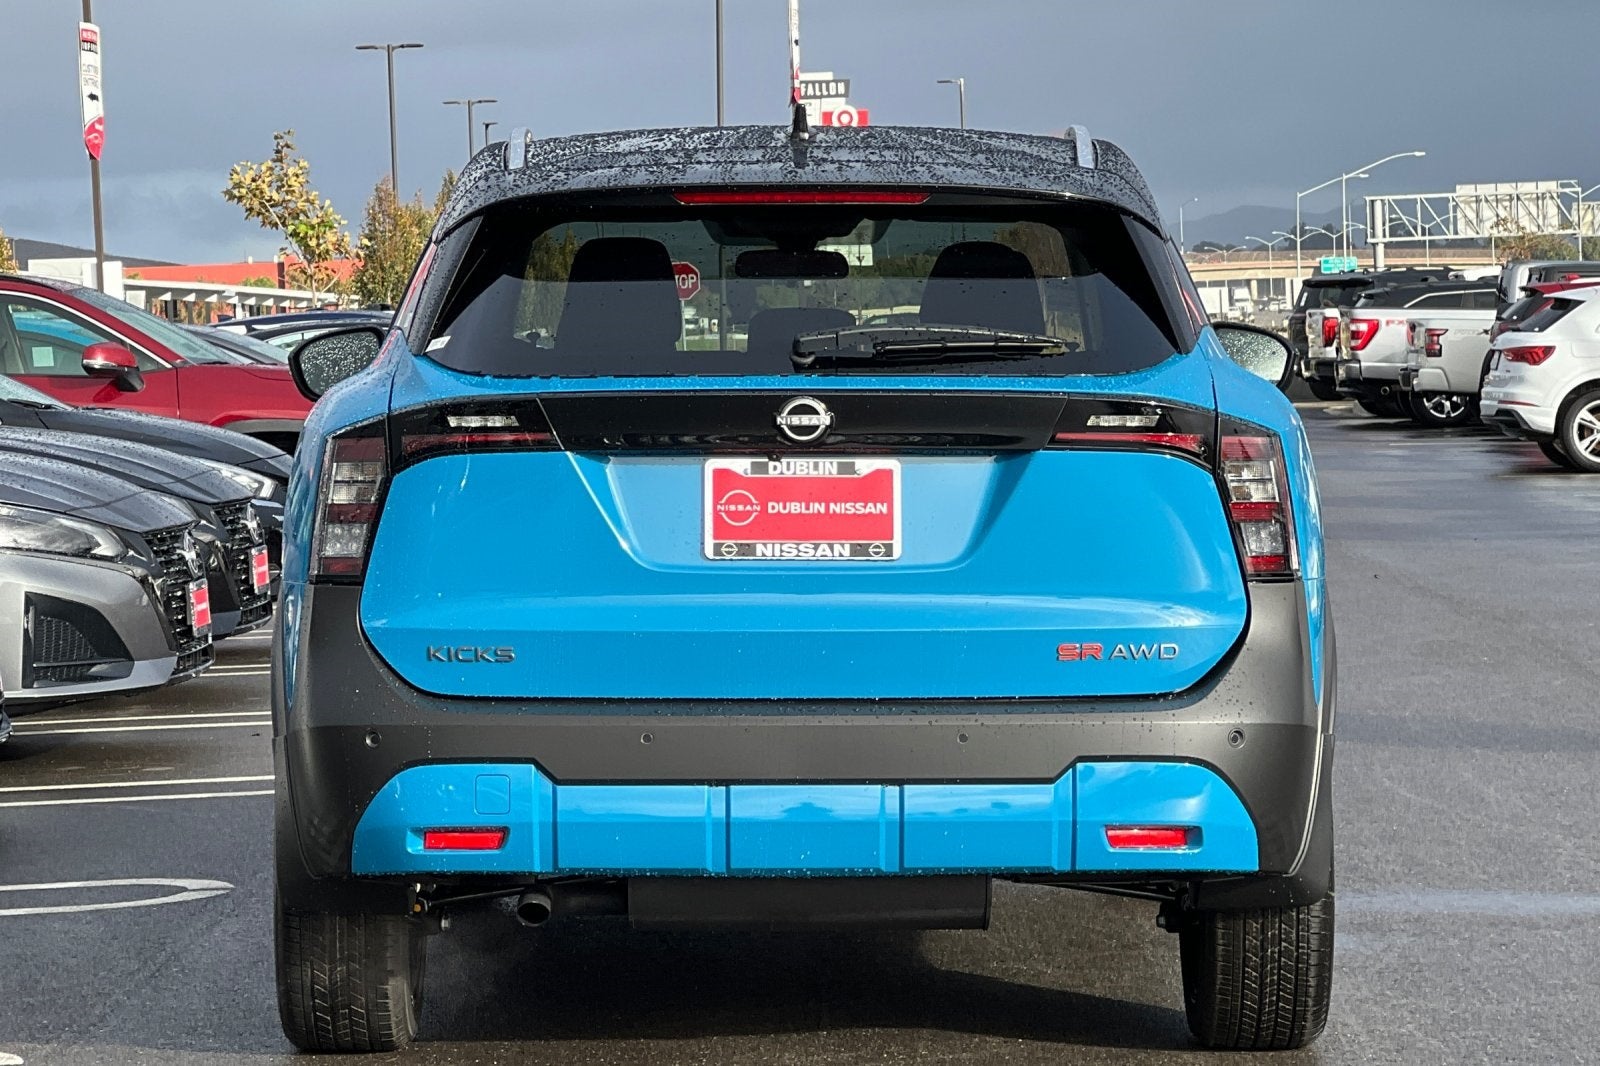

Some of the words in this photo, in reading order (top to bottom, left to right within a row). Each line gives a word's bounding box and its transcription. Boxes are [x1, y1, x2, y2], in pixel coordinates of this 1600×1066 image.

[800, 81, 845, 97] FALLON
[776, 416, 831, 426] NISSAN
[768, 461, 838, 475] DUBLIN
[716, 503, 761, 511] NISSAN
[767, 501, 825, 515] DUBLIN
[829, 501, 888, 515] NISSAN
[755, 543, 851, 557] NISSAN
[426, 645, 515, 663] KICKS
[1056, 642, 1103, 661] SR
[1109, 642, 1180, 661] AWD
